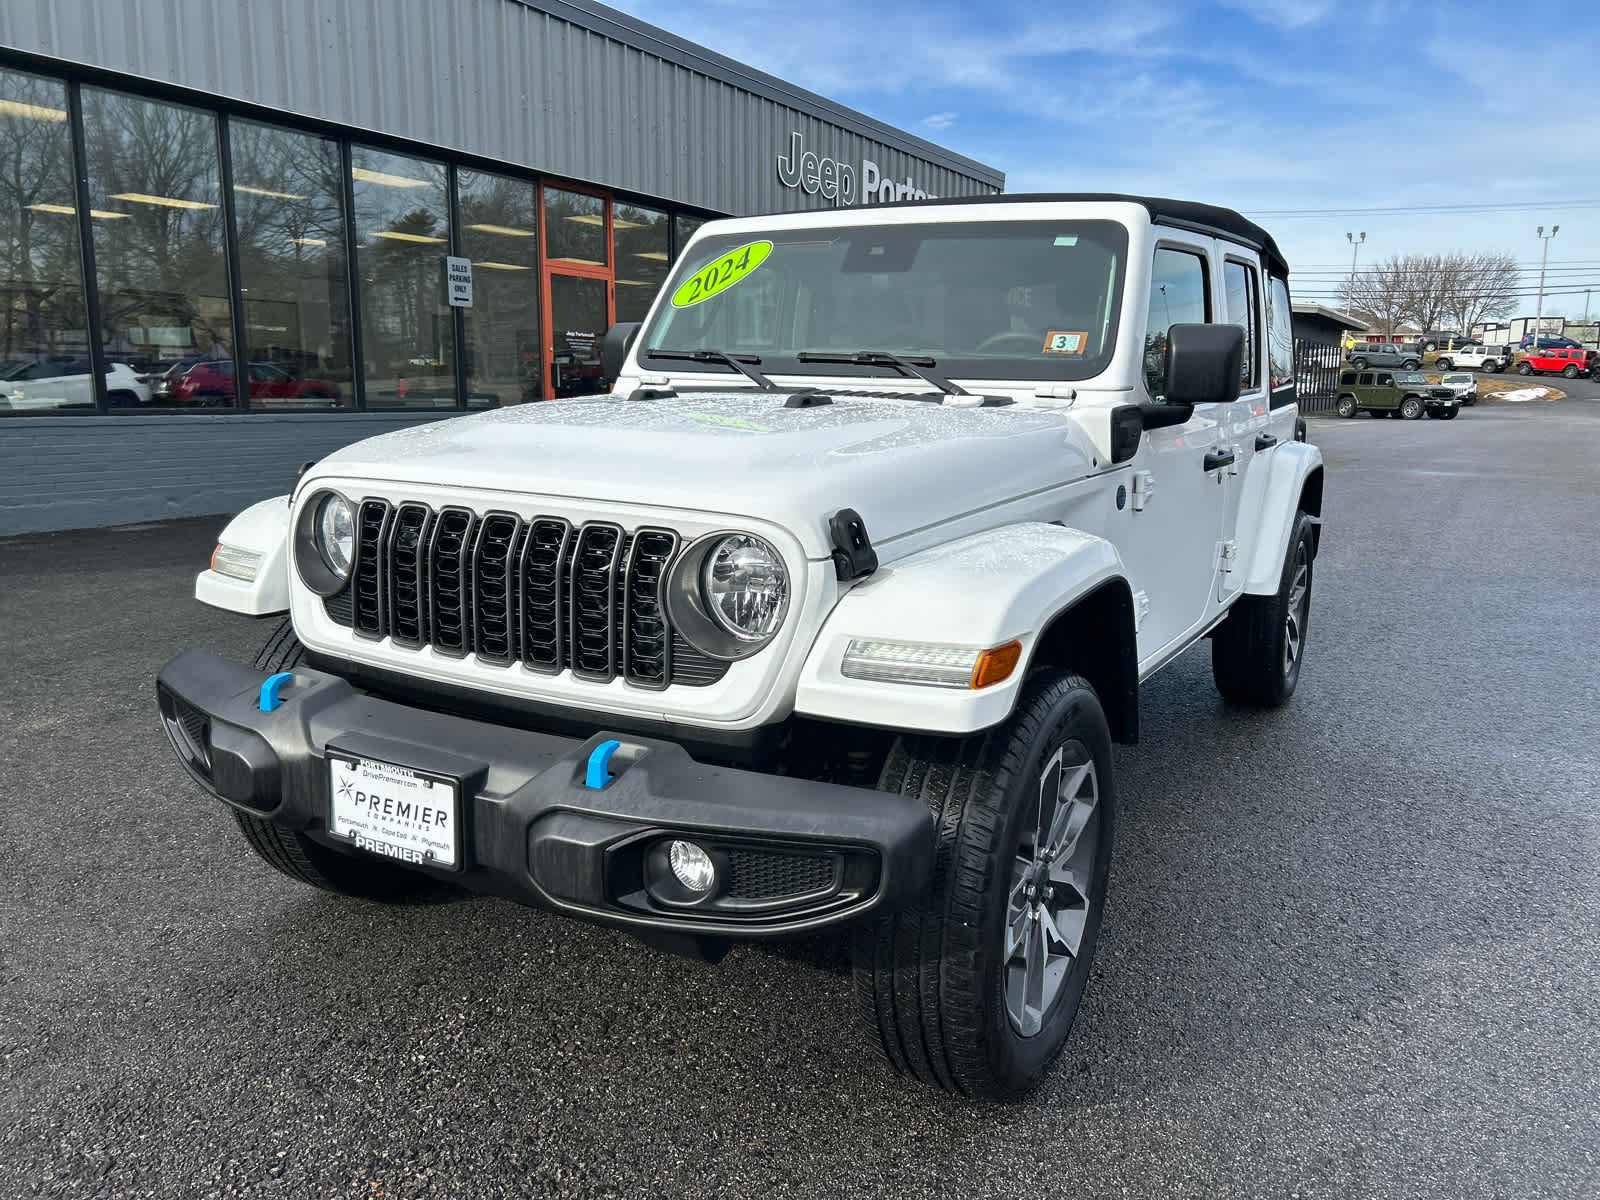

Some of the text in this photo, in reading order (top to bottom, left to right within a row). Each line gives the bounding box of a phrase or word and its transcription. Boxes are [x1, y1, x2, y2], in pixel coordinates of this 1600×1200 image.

[778, 132, 856, 207] Jeep
[449, 273, 471, 283] PARKING
[452, 264, 468, 273] SALES
[688, 247, 751, 303] 2024
[454, 285, 467, 293] ONLY
[1056, 336, 1067, 348] 3
[363, 770, 418, 789] DrivePremier.com
[354, 791, 448, 828] PREMIER
[367, 811, 430, 832] COMPANIES
[338, 816, 369, 829] Portsmouth
[421, 837, 450, 851] Plymouth
[355, 836, 424, 864] PREMIER
